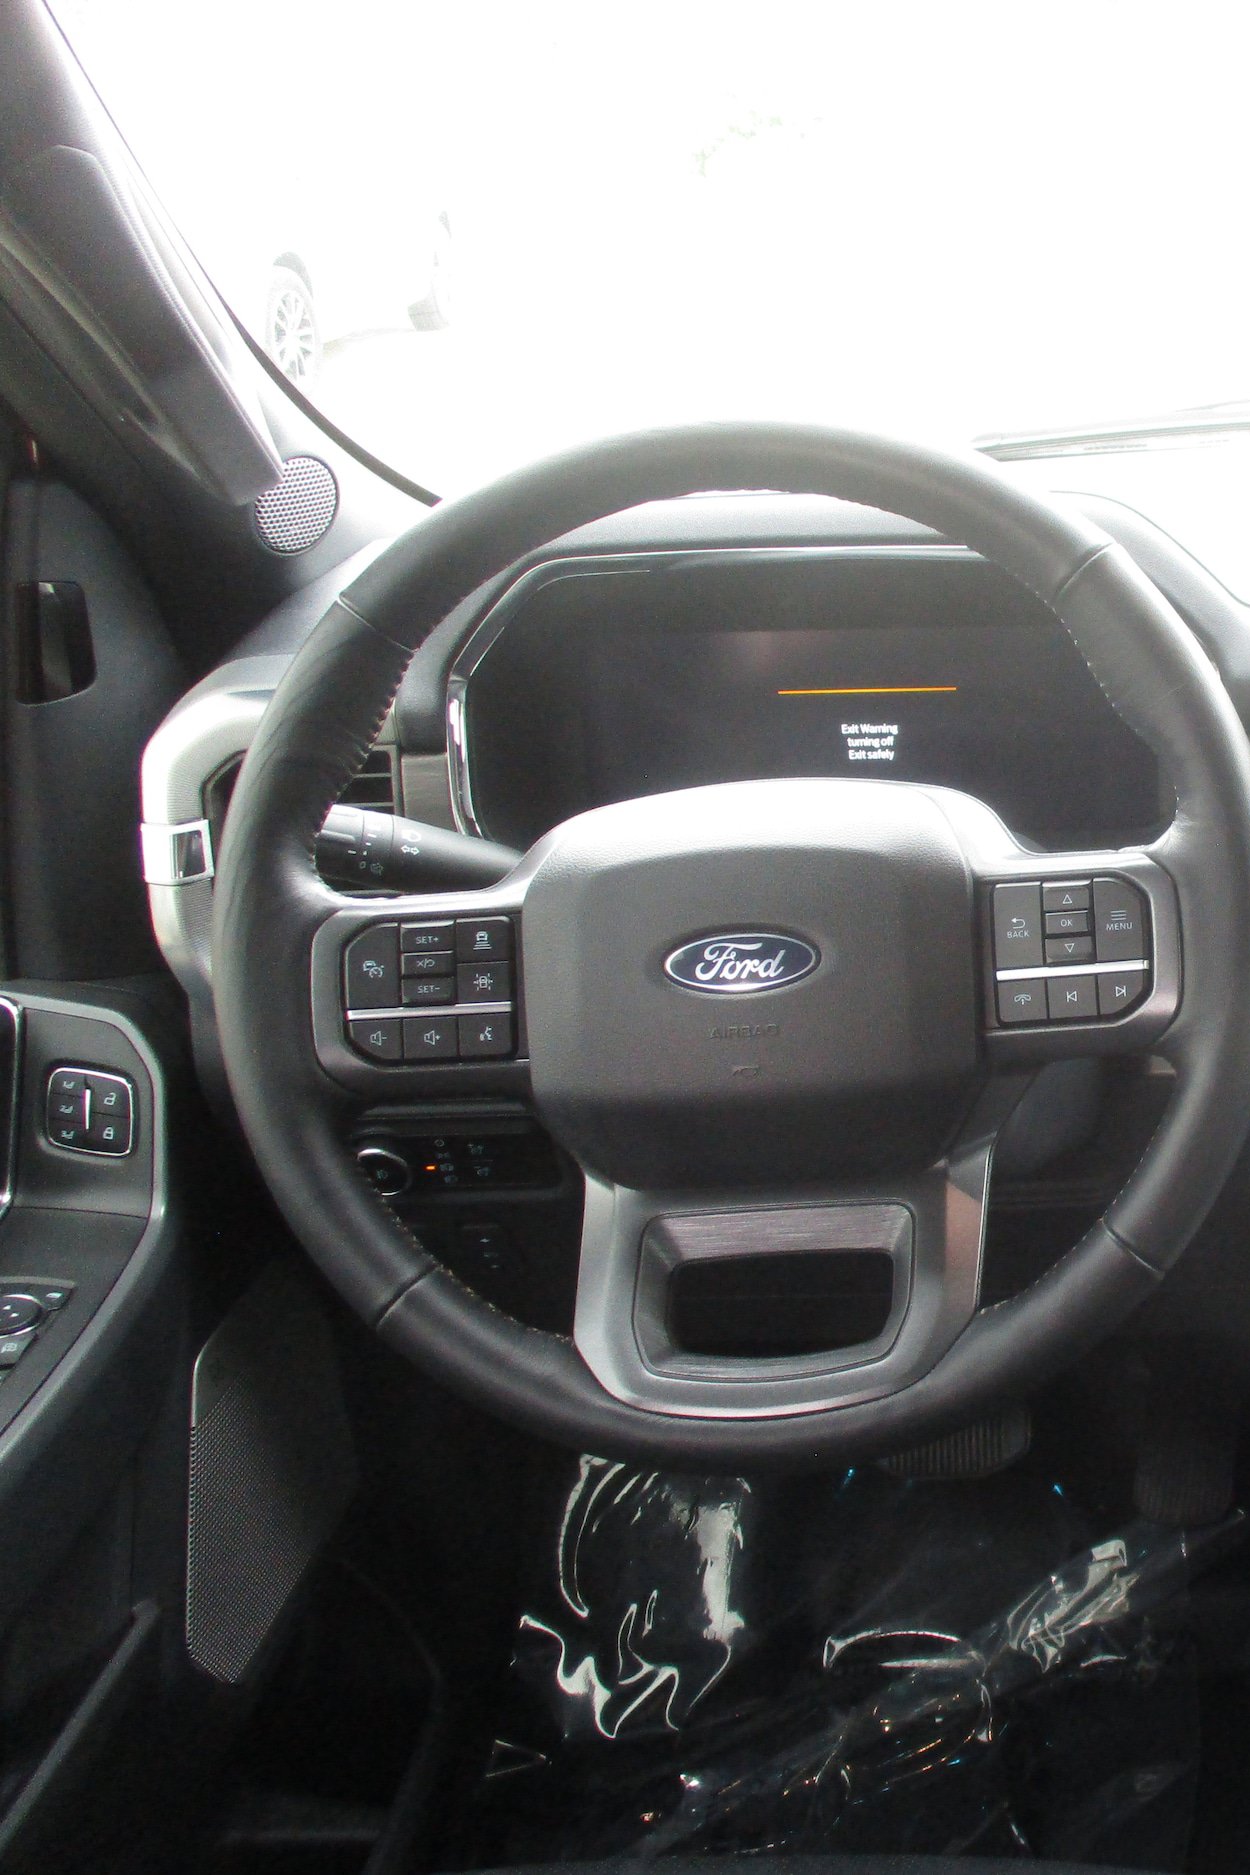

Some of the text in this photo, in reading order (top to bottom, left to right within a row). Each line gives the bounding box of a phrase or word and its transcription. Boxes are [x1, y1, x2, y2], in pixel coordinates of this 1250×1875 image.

[841, 723, 898, 735] Exit Warning
[847, 736, 894, 748] turning off
[848, 749, 894, 760] Exit safely
[1061, 919, 1073, 927] OK
[1106, 923, 1133, 931] MENU
[1007, 931, 1029, 939] BACK
[695, 942, 786, 981] Ford
[708, 1023, 780, 1040] AIRBAG
